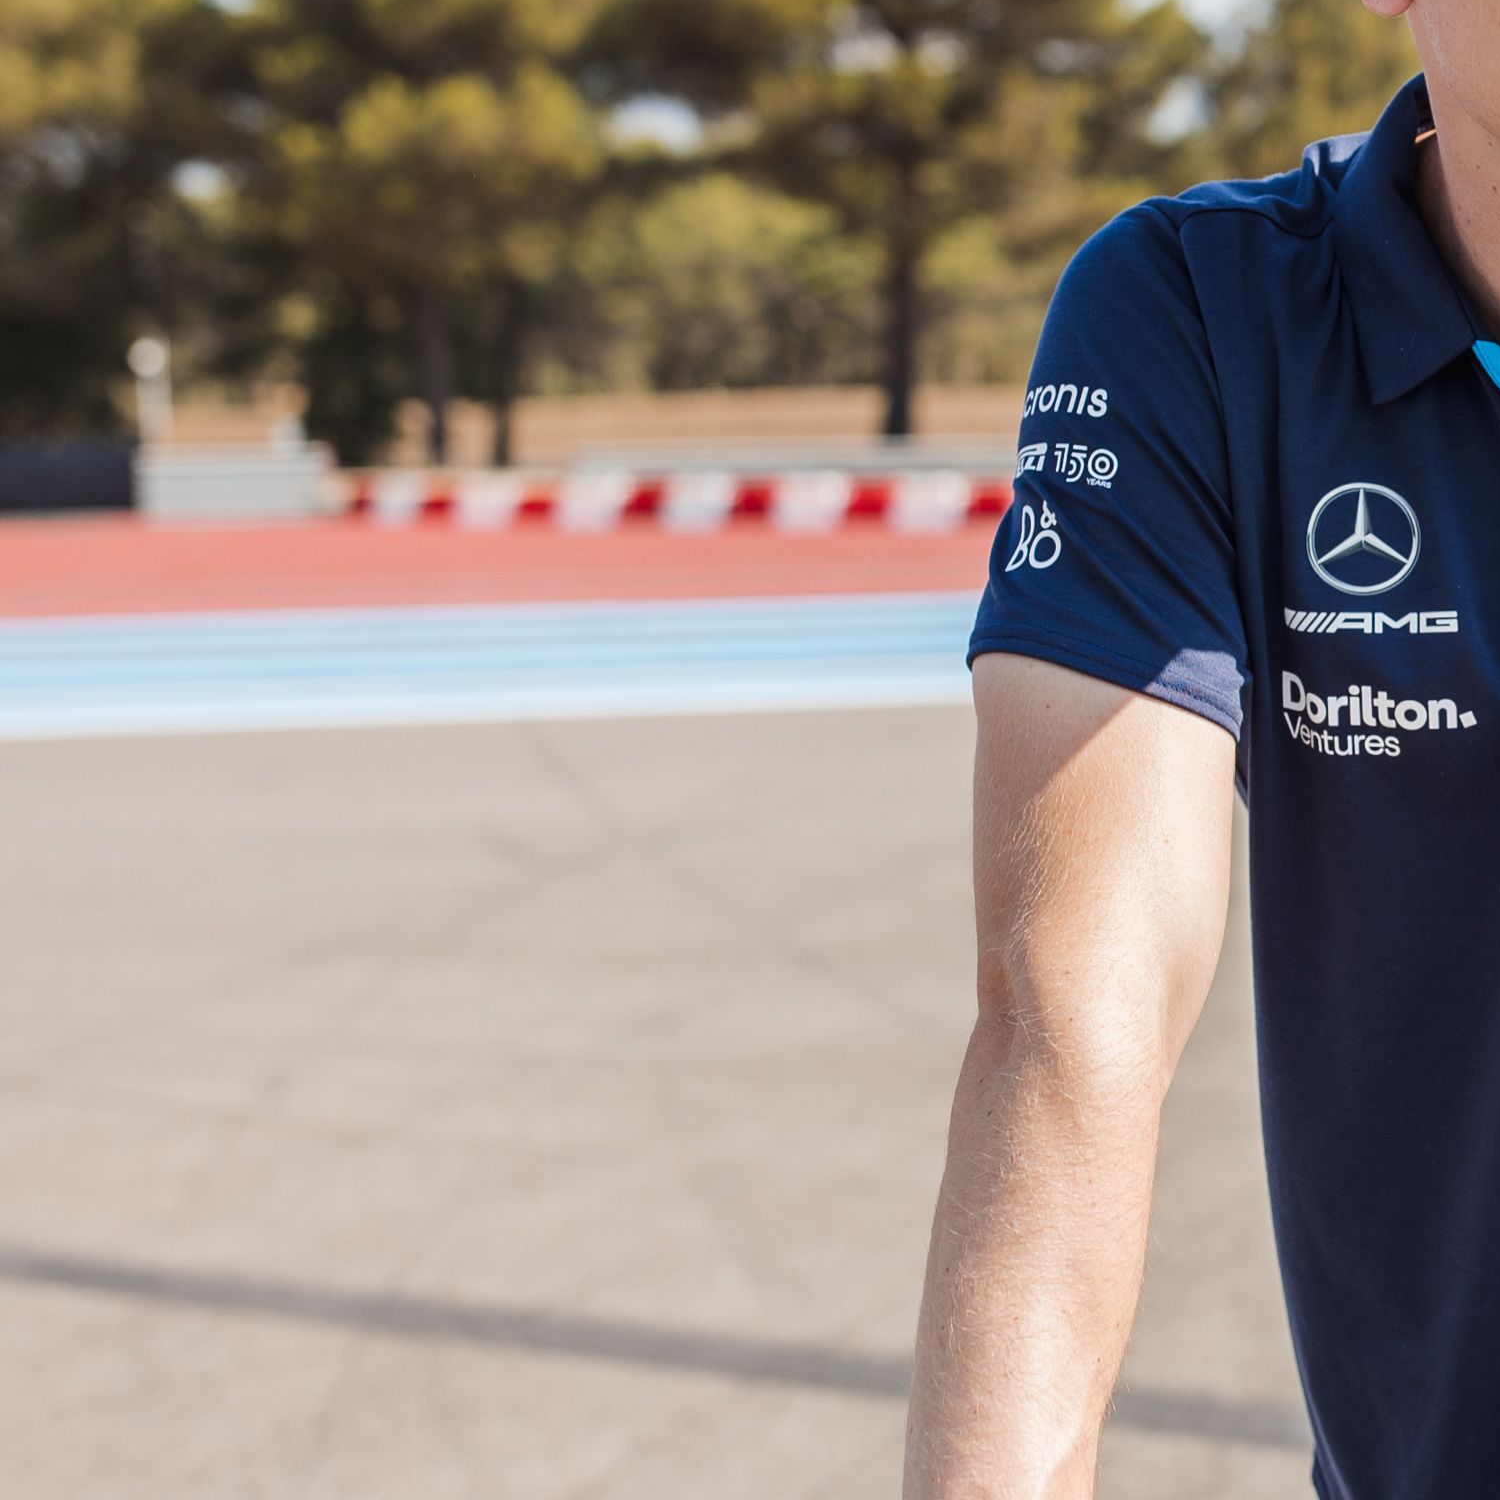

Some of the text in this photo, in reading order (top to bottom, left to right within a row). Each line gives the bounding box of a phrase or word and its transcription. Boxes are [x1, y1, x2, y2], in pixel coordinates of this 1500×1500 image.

[1054, 443, 1118, 483] 150
[1086, 477, 1112, 489] YEARS
[1284, 711, 1401, 757] Ventures
